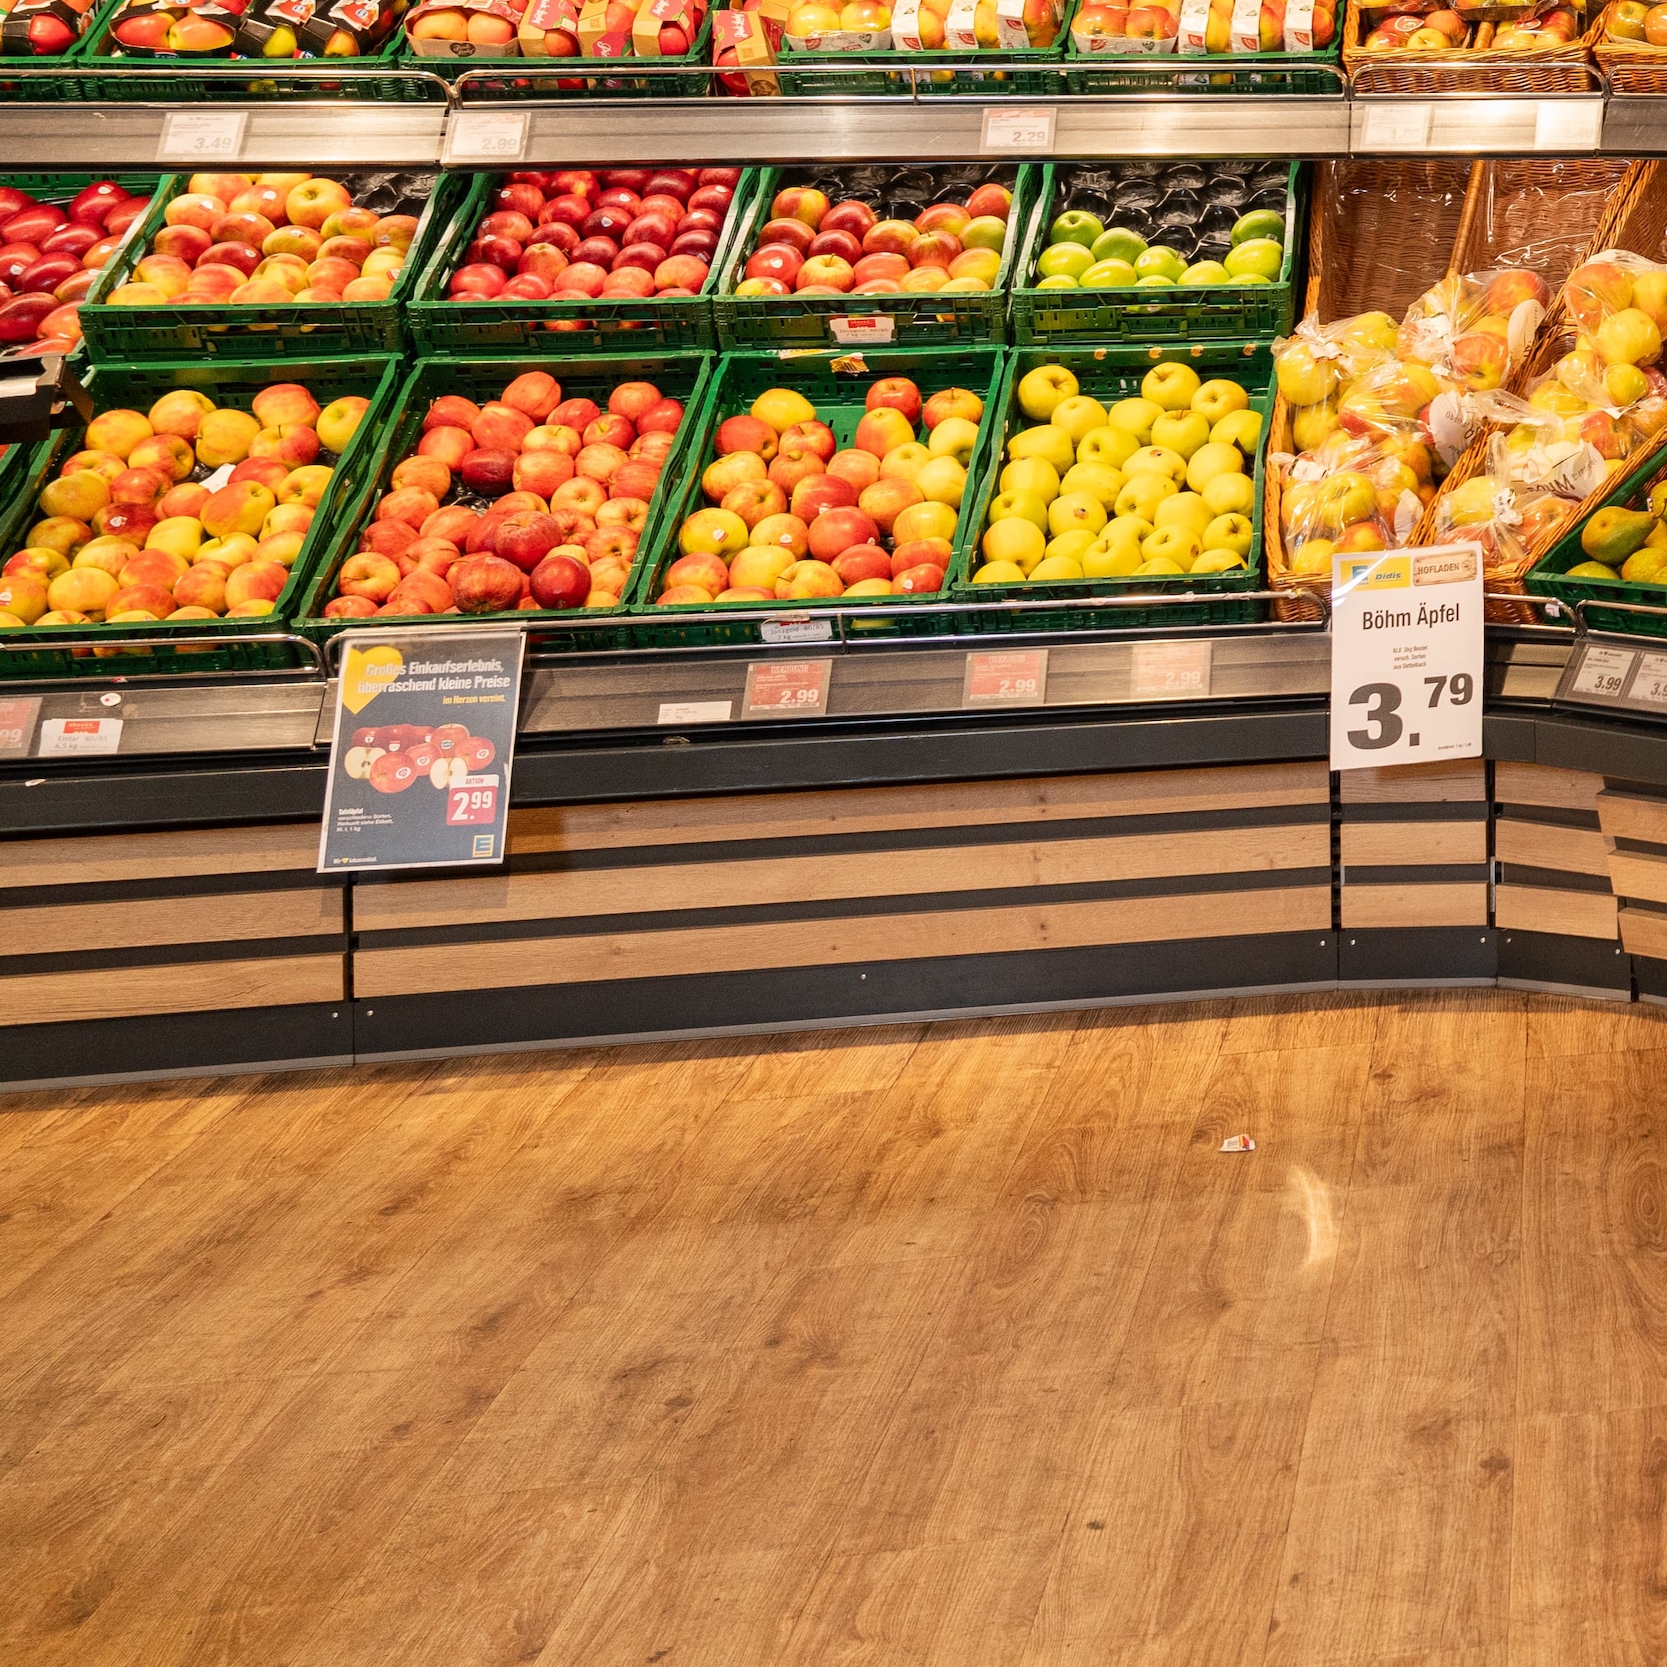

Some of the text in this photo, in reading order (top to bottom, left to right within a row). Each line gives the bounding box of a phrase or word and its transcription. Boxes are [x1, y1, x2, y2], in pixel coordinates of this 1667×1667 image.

[193, 137, 232, 151] 3.49
[1012, 131, 1046, 143] 2.29
[481, 138, 518, 151] 2.99
[1417, 562, 1460, 575] HOFLADEN
[1375, 572, 1402, 581] Didis
[1363, 602, 1460, 630] Böhm Äpfel
[366, 659, 504, 677] Großes Einkaufserlebnis,
[358, 675, 510, 694] überraschend kleine Preise
[1165, 671, 1200, 686] 2.99
[1594, 675, 1621, 692] 3.99
[1000, 679, 1036, 693] 2.99
[442, 693, 506, 705] im Herzen vereint.
[780, 689, 819, 703] 2.99
[1347, 673, 1474, 750] 3.79
[451, 791, 493, 821] 2.99
